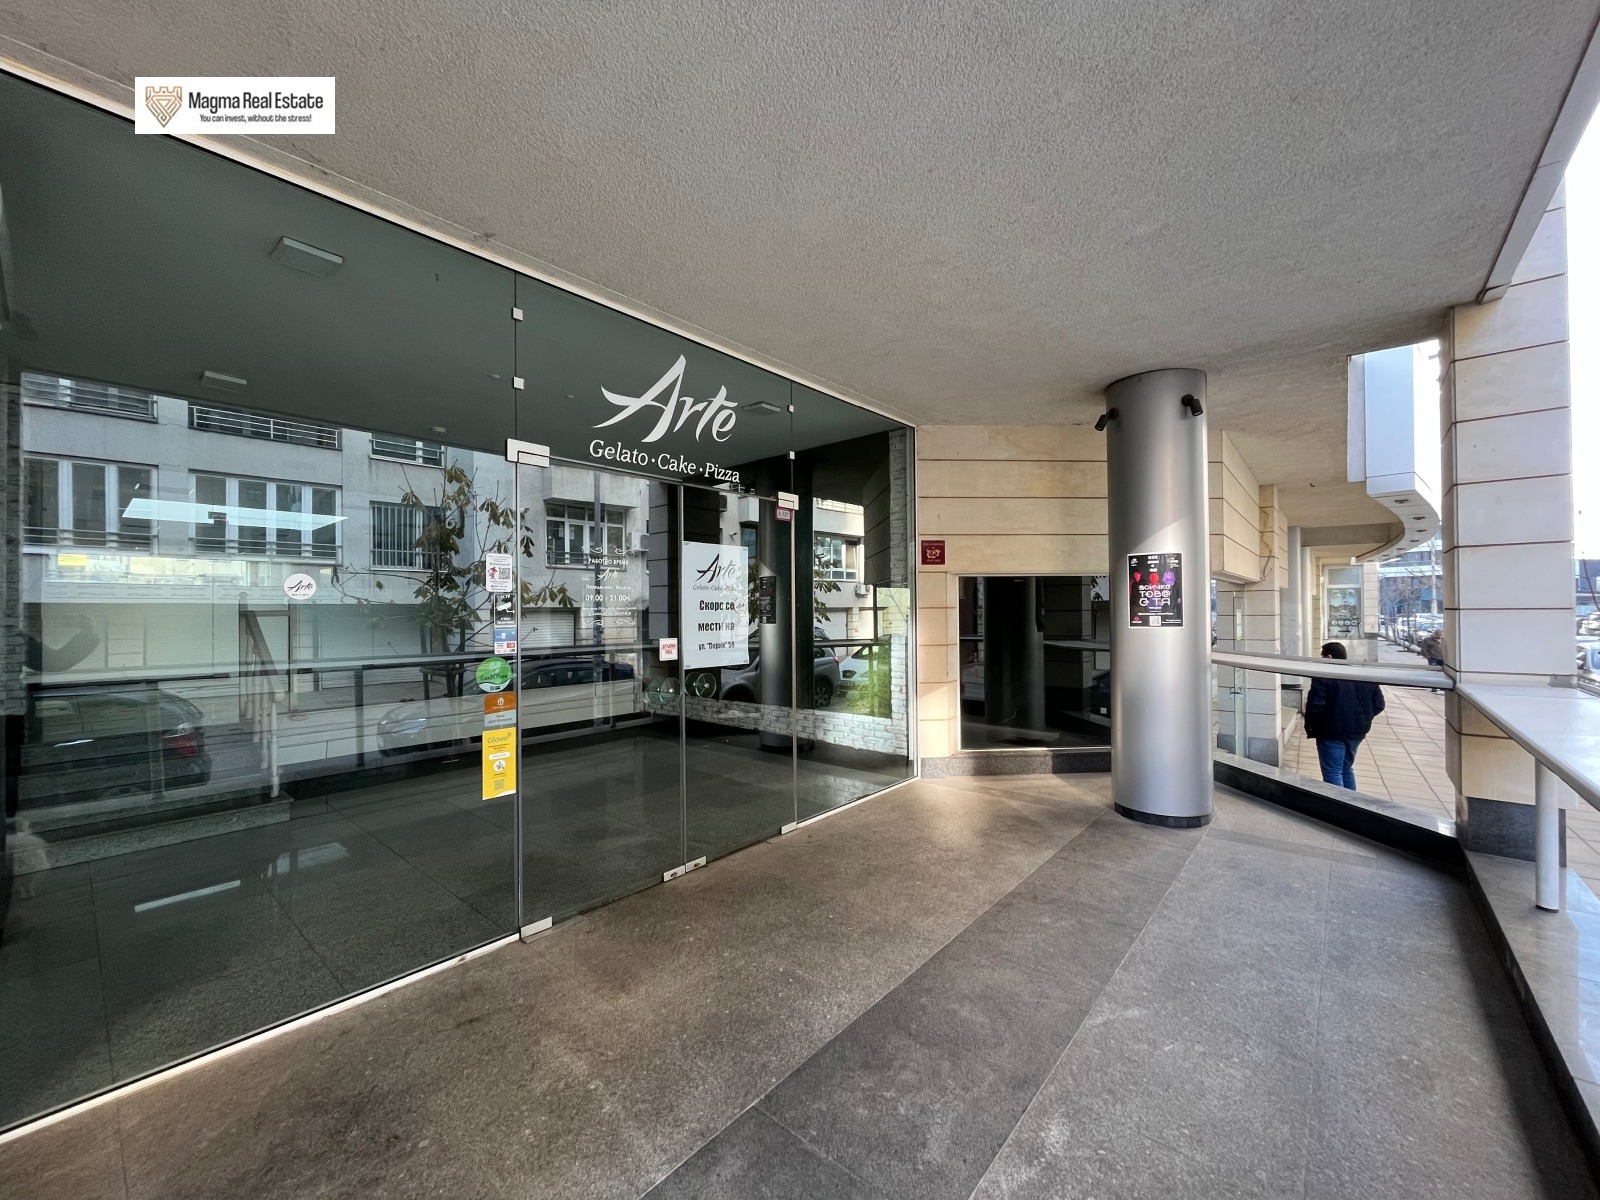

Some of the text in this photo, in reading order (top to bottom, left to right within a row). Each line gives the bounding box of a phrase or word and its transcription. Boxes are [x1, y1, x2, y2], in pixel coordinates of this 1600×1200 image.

[591, 354, 738, 443] Arte
[589, 439, 740, 483] Gelato Cake Pizza
[695, 553, 736, 583] Arte
[725, 601, 735, 611] се
[698, 622, 735, 631] мести на
[487, 734, 509, 744] Glovo
